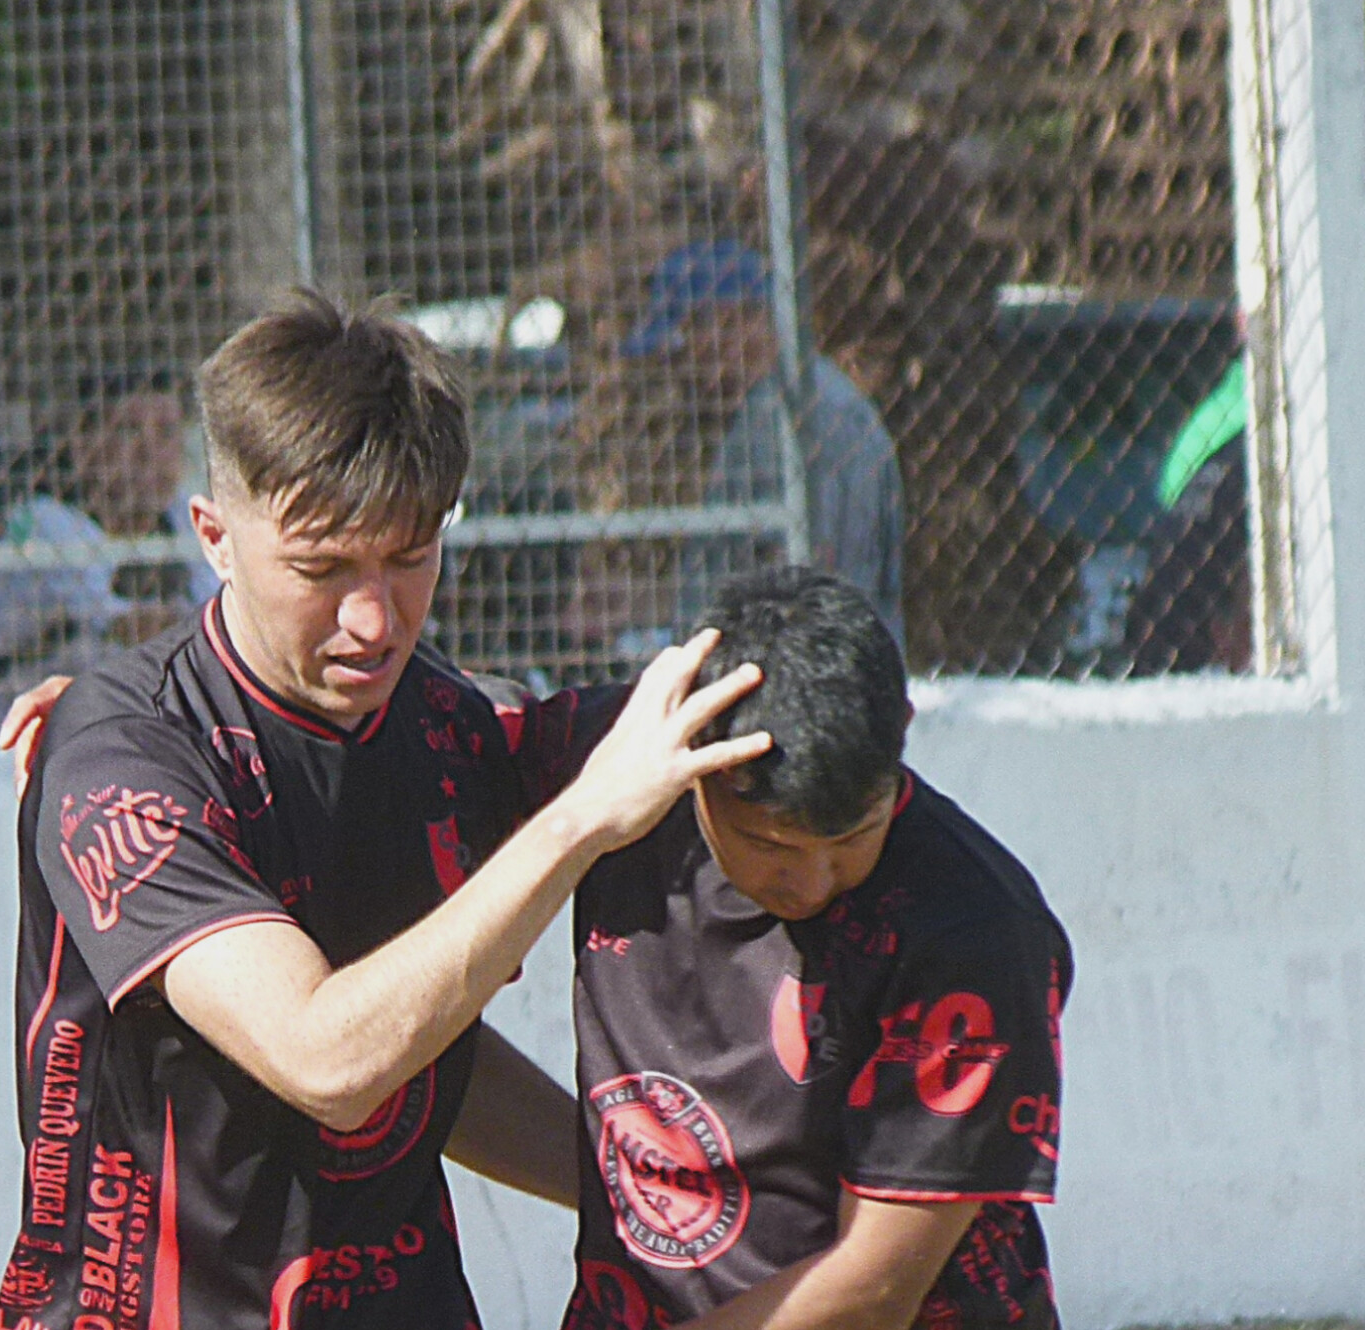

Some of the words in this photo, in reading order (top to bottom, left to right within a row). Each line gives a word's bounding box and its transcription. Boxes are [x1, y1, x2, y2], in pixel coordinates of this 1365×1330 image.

[37, 1018, 85, 1137] QUEVEDO
[29, 1136, 70, 1227] PEDRIN
[81, 1142, 134, 1295] BLACK
